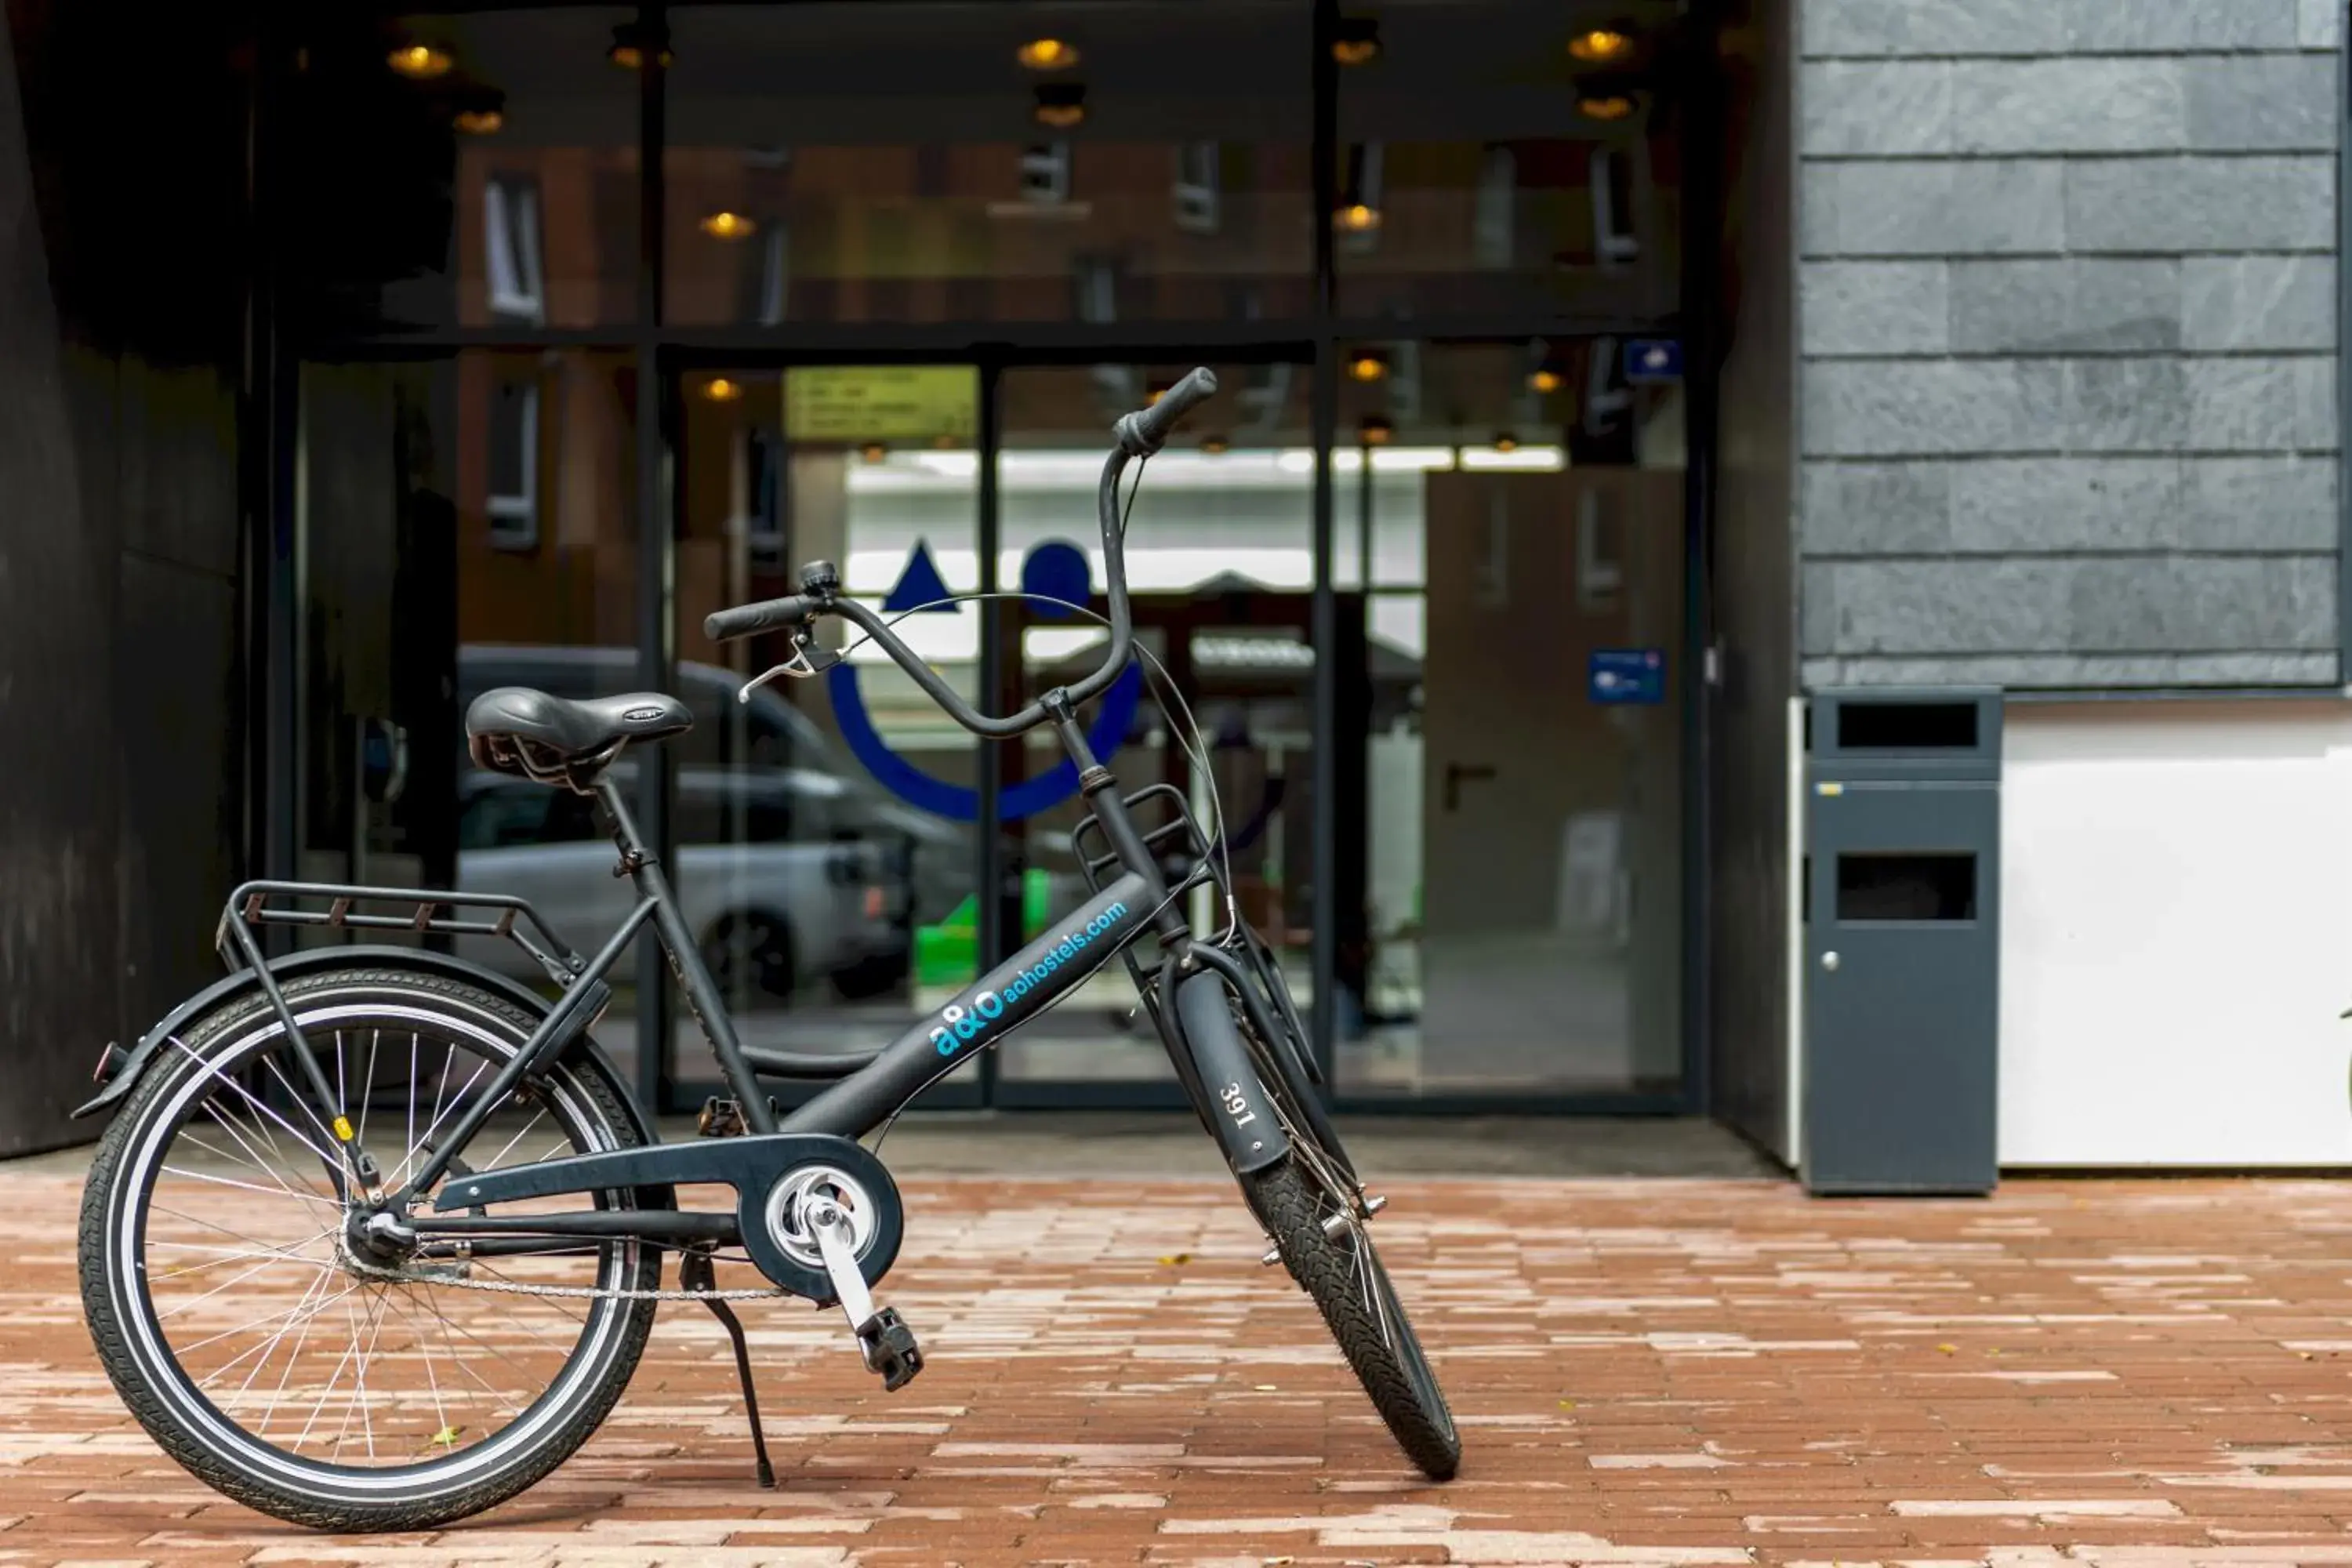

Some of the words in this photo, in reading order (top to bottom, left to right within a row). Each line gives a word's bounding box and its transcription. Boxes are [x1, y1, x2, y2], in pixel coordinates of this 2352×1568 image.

[929, 991, 1004, 1056] a&o
[1003, 902, 1127, 1004] aohostels.com
[1220, 1083, 1256, 1129] 391
